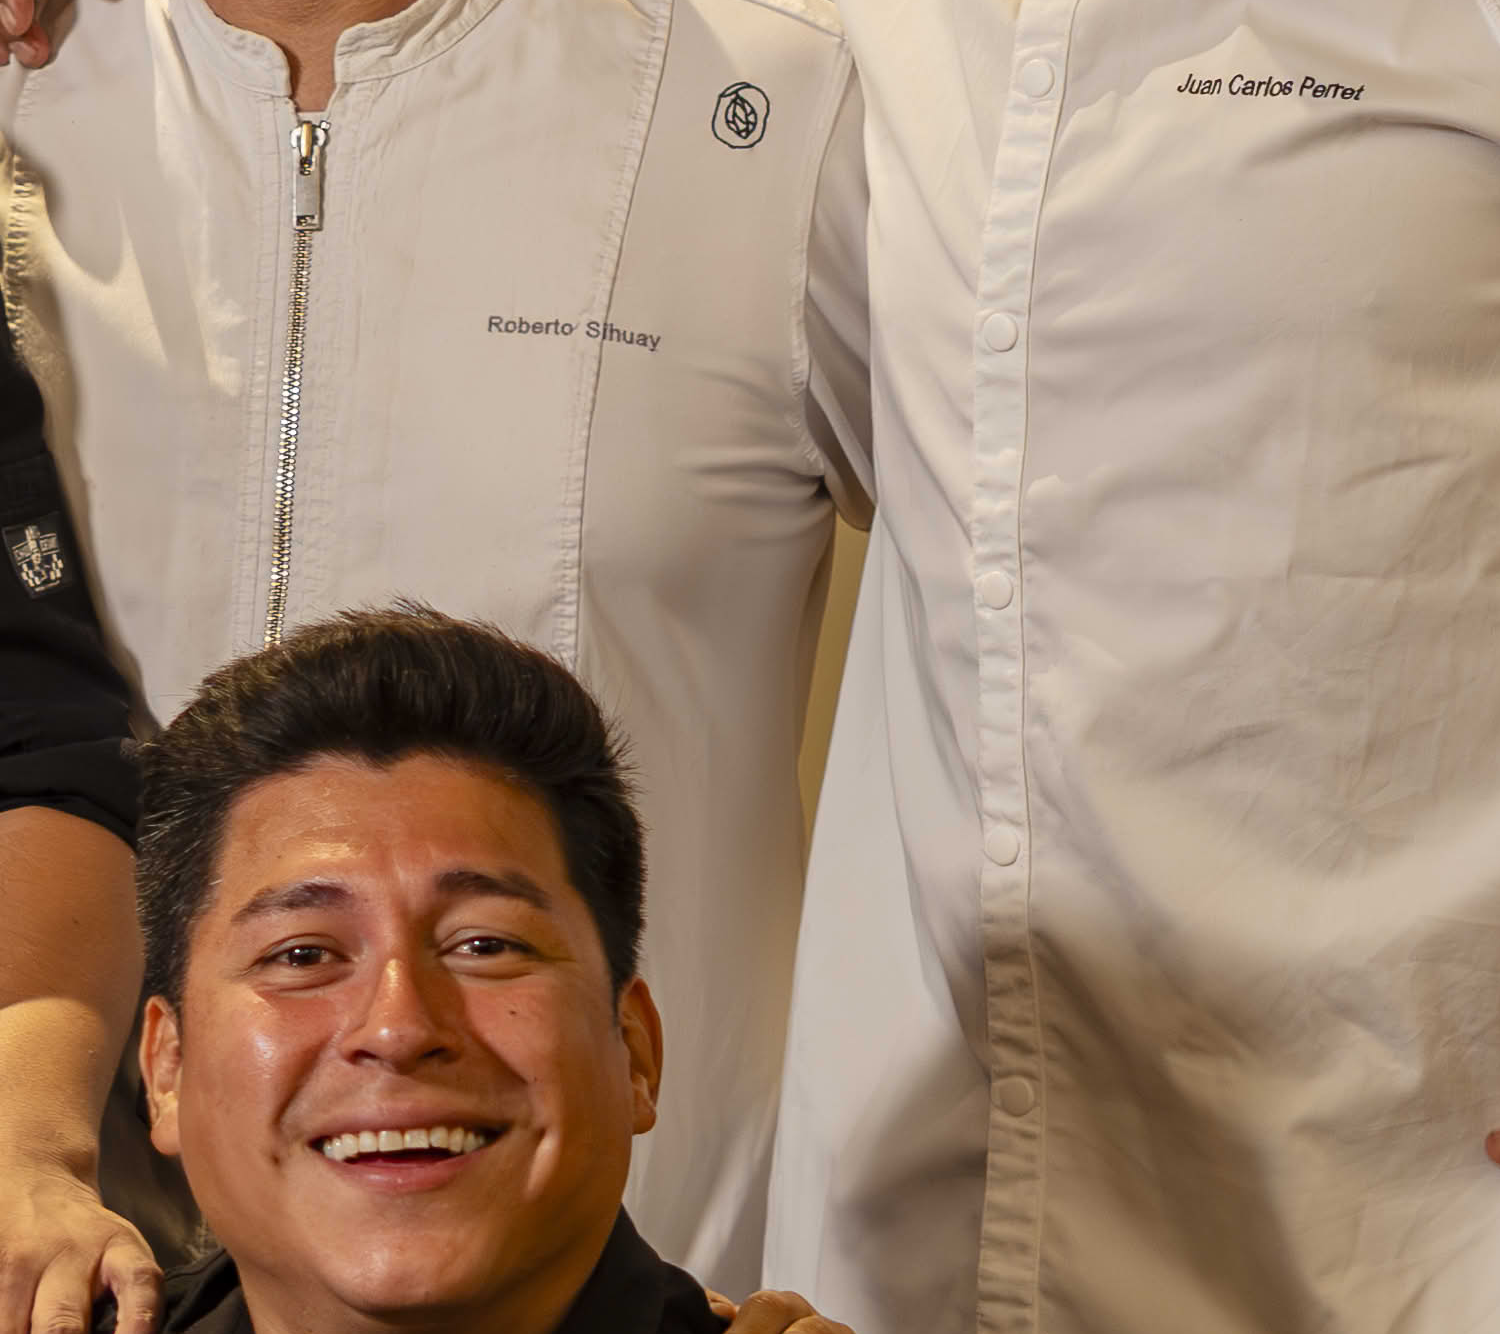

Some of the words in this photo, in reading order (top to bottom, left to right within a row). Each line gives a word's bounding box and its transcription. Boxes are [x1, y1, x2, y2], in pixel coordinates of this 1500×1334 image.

[1176, 73, 1222, 95] Juan
[1228, 74, 1293, 97] Carlos
[1299, 76, 1365, 101] Perret
[488, 316, 574, 336] Roberto
[585, 321, 661, 351] Sihuay
